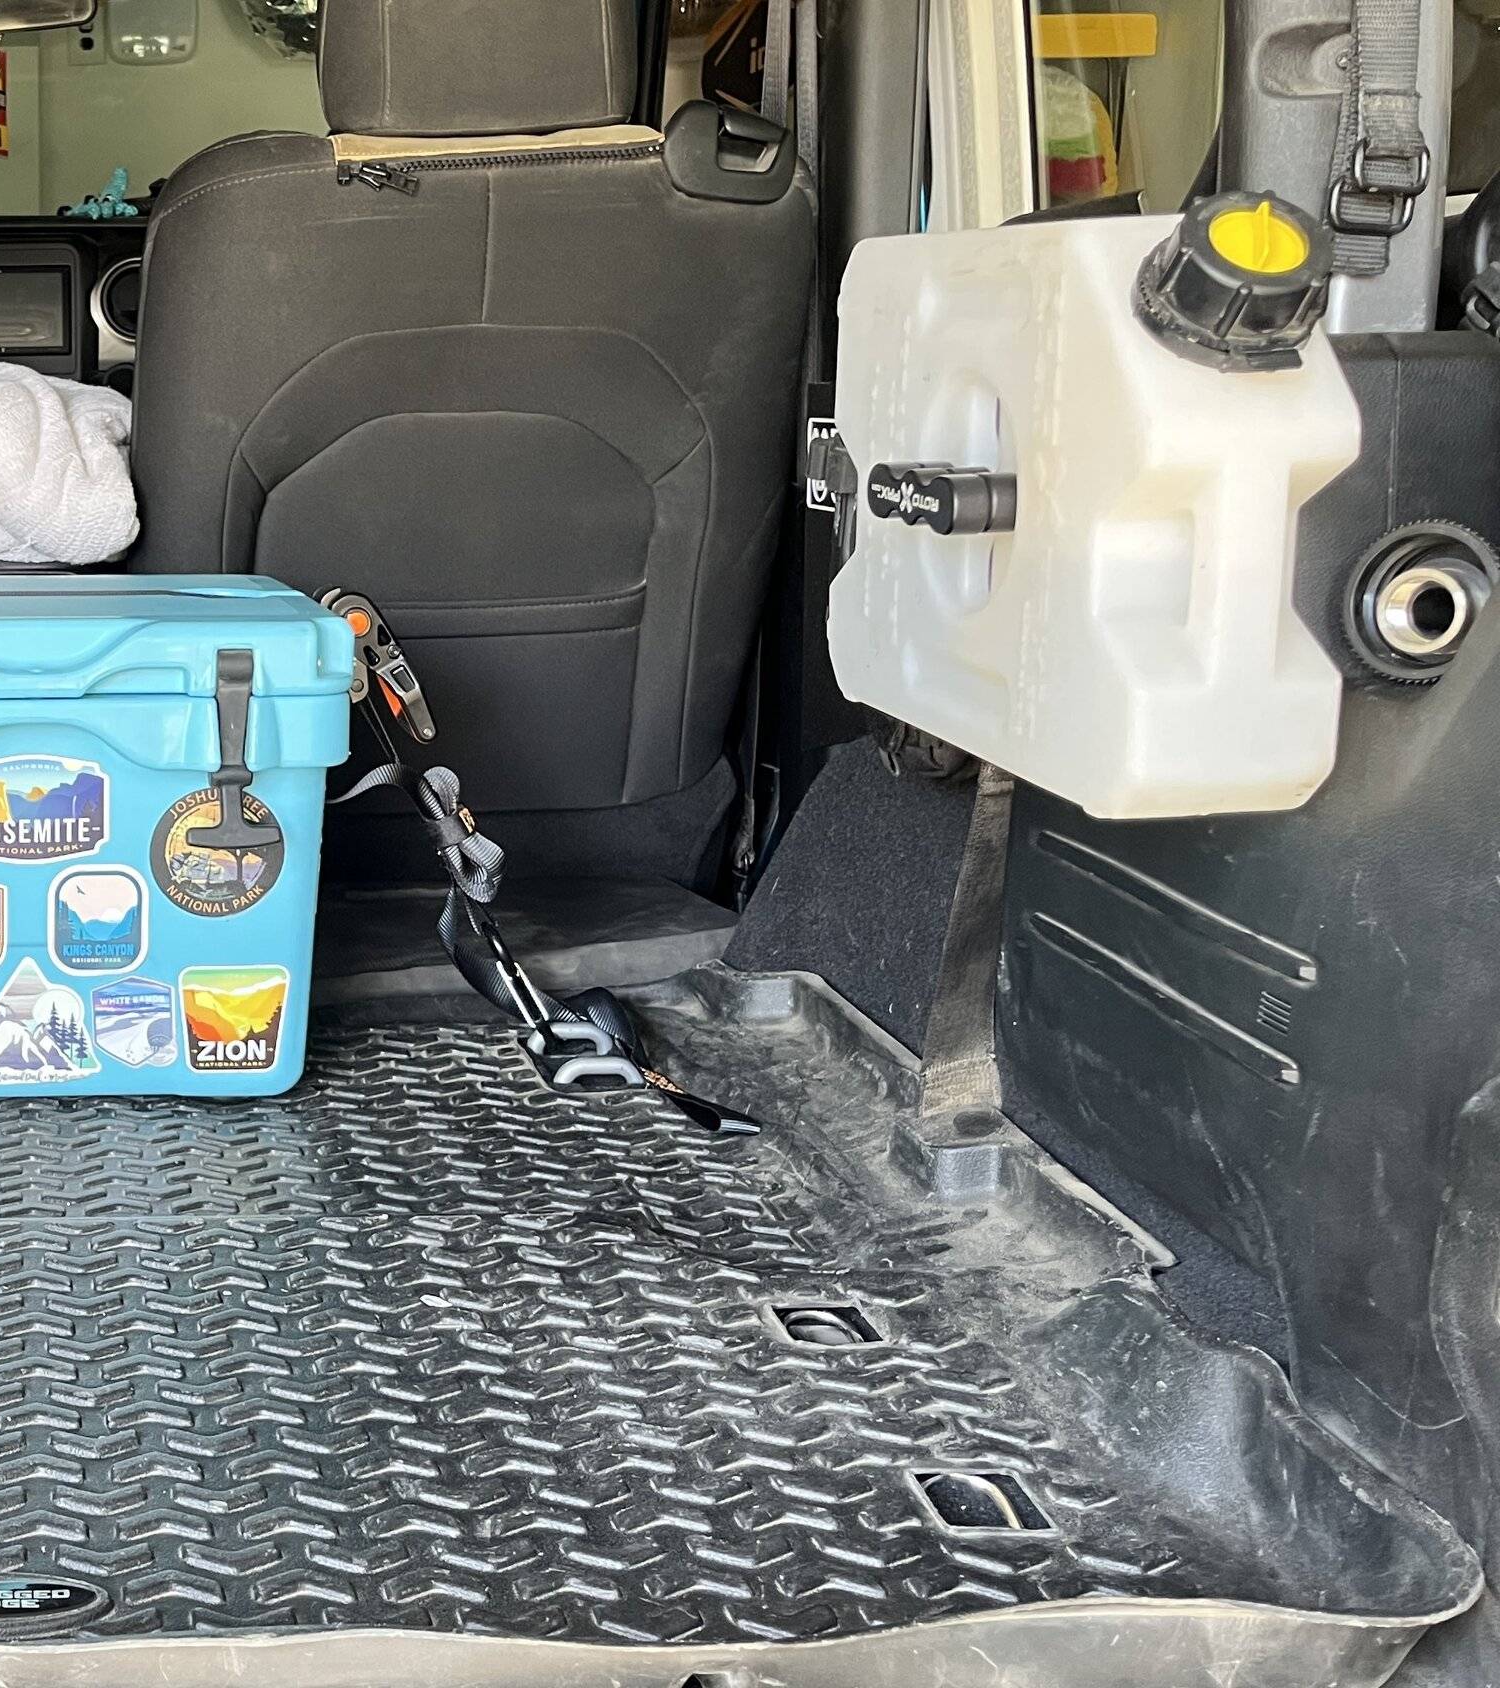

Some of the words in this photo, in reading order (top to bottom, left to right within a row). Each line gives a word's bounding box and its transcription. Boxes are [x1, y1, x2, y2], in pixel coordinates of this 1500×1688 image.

[169, 788, 218, 820] JOSHU
[243, 795, 269, 819] REE
[47, 844, 79, 853] PARK
[166, 884, 229, 913] NATIONAL
[232, 884, 264, 909] PARK
[63, 944, 93, 956] KINGS
[95, 943, 134, 956] CANYON
[101, 996, 130, 1005] WHITE
[196, 1039, 267, 1062] ZION
